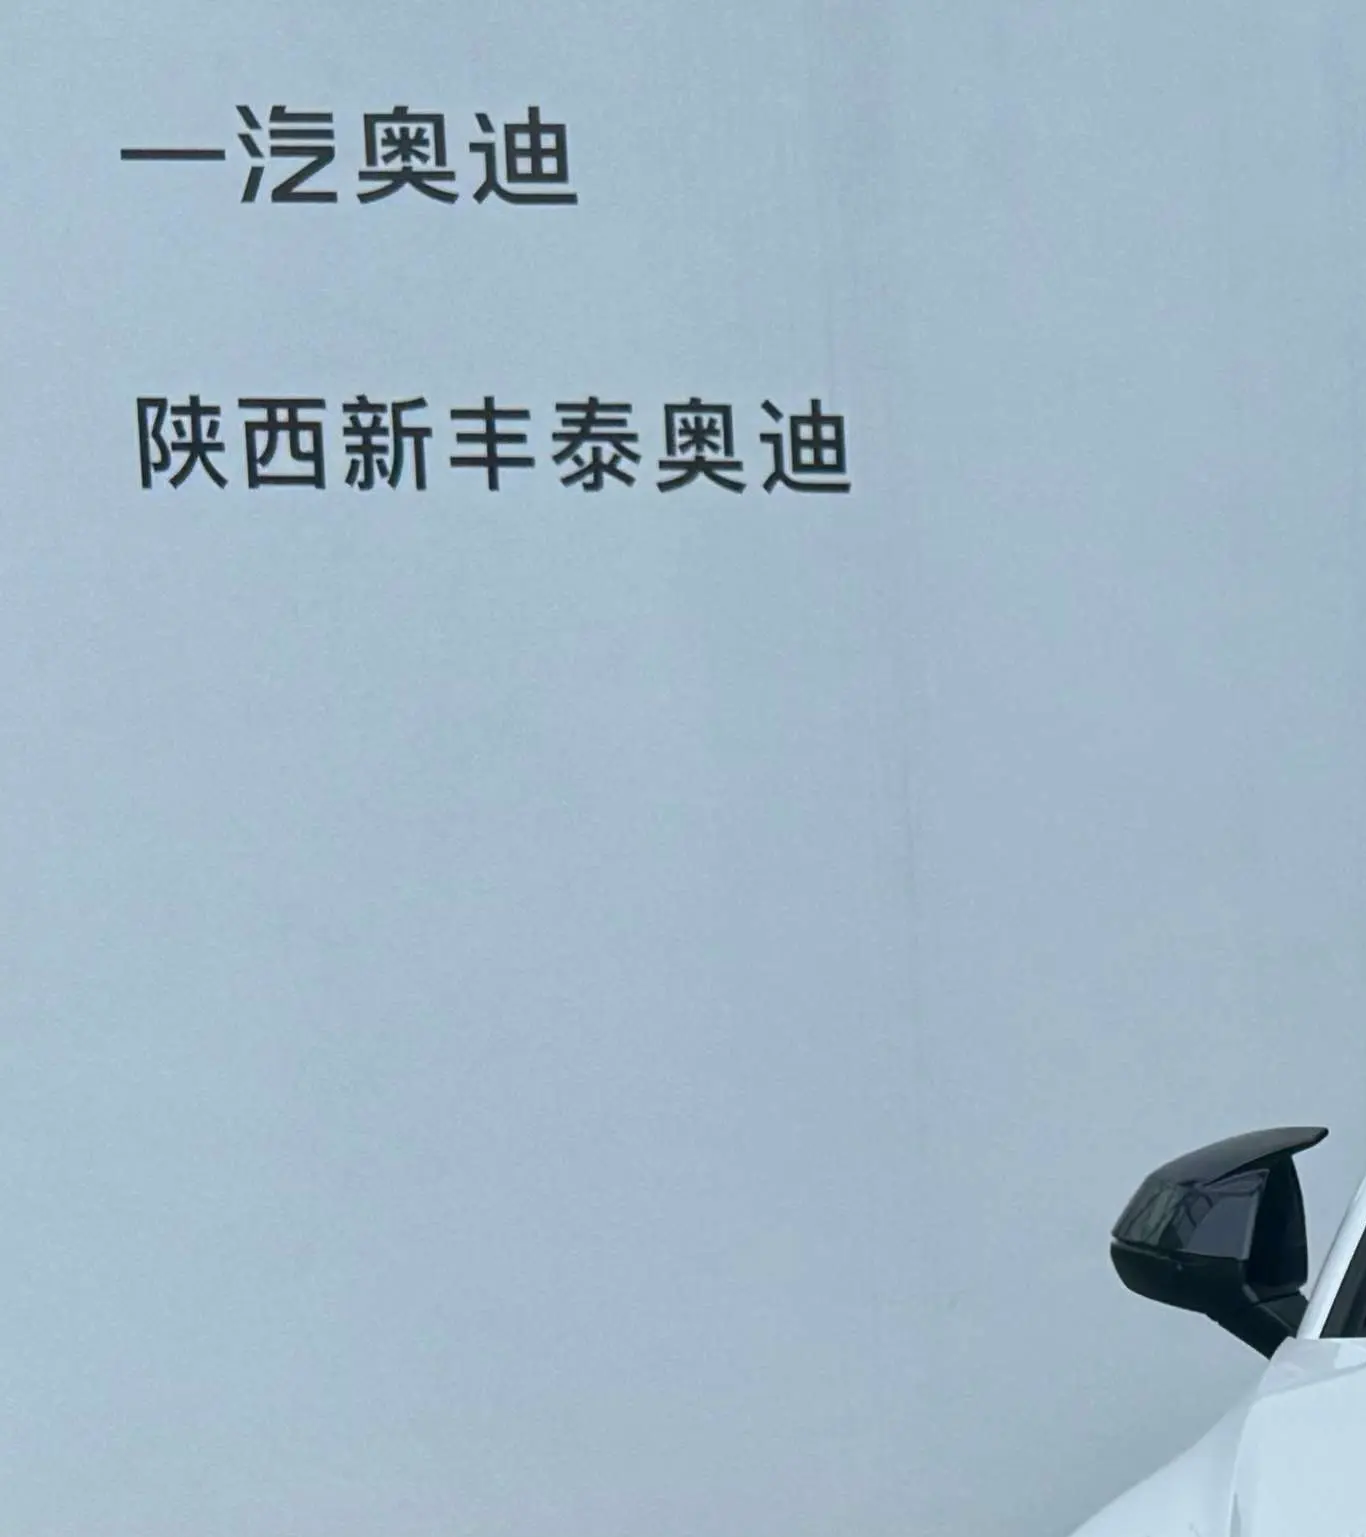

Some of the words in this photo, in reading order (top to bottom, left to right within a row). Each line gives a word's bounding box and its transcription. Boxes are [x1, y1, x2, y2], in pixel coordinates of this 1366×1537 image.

[120, 105, 578, 205] 一汽奥迪
[136, 394, 851, 494] 陕西新丰泰奥迪
